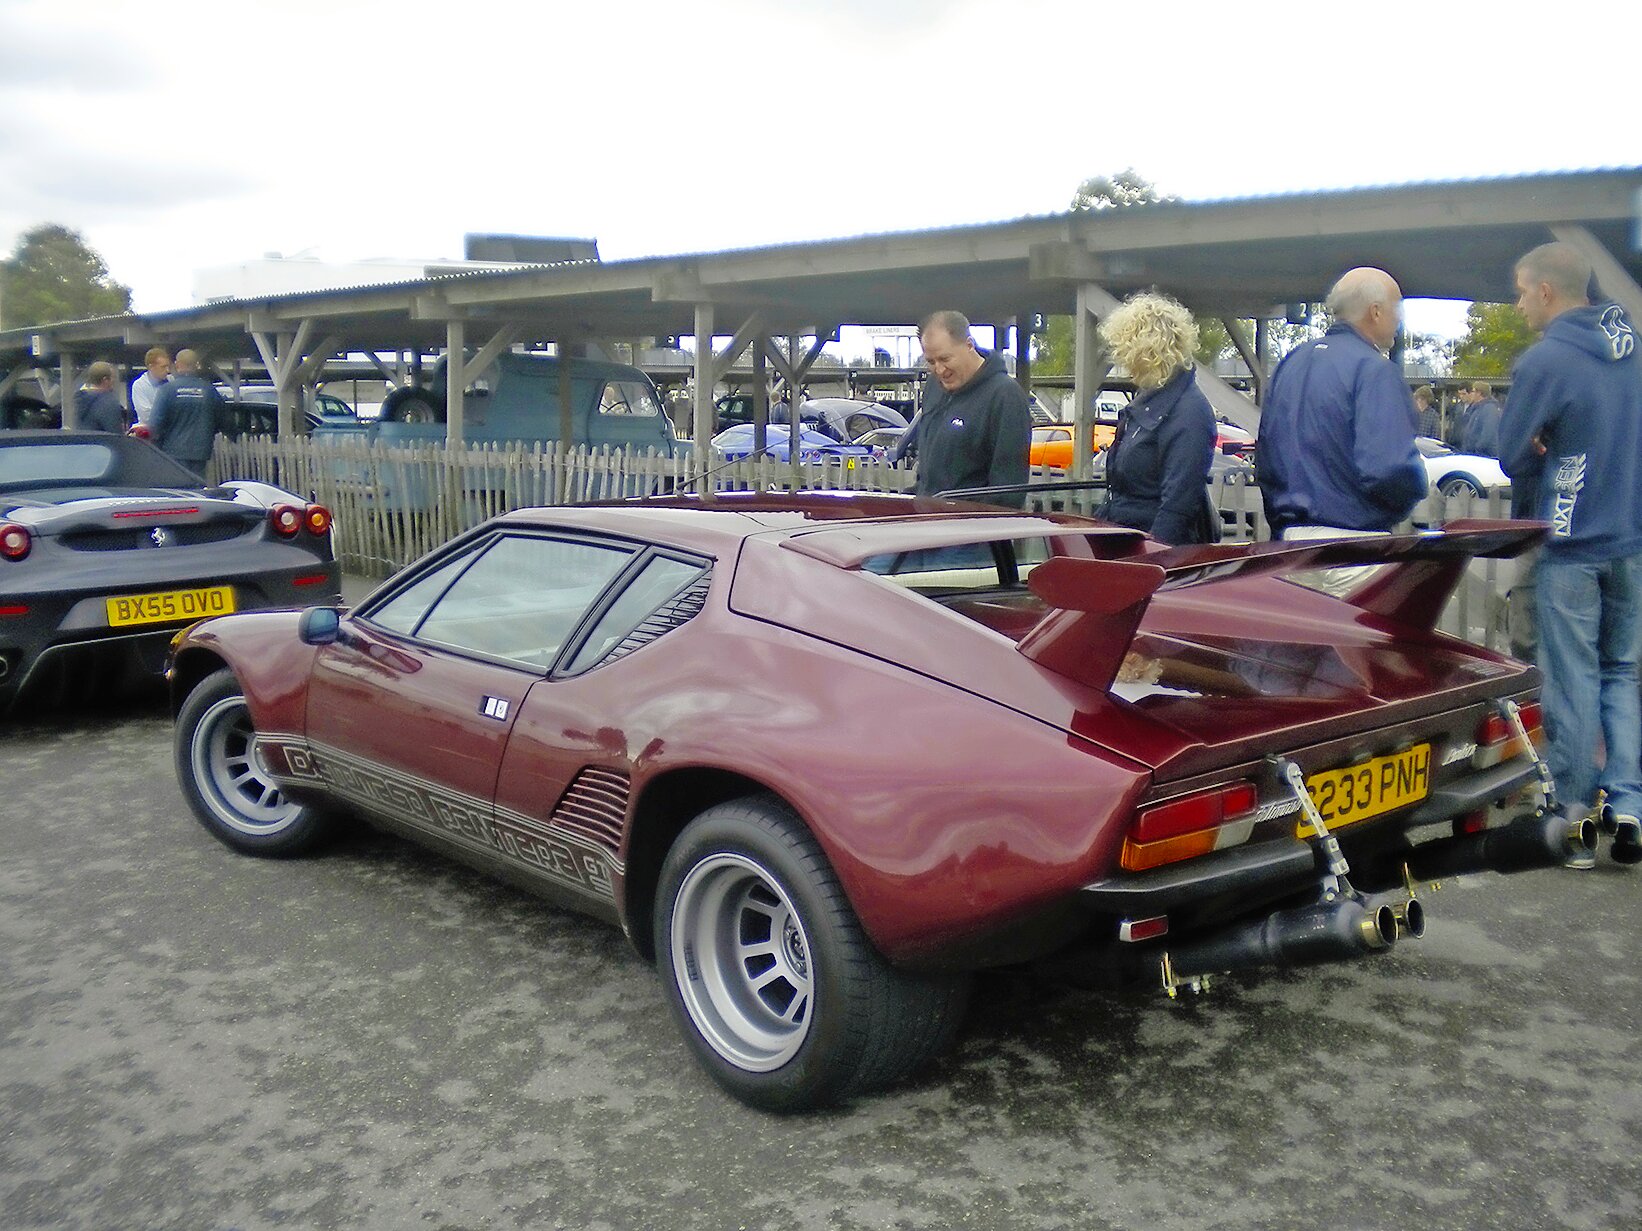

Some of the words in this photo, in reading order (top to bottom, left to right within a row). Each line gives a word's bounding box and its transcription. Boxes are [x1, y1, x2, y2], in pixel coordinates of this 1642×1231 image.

[1035, 313, 1042, 327] 3
[1300, 302, 1307, 318] 2
[116, 596, 176, 621] BX55
[182, 590, 224, 614] OVO
[1379, 750, 1430, 804] PNH
